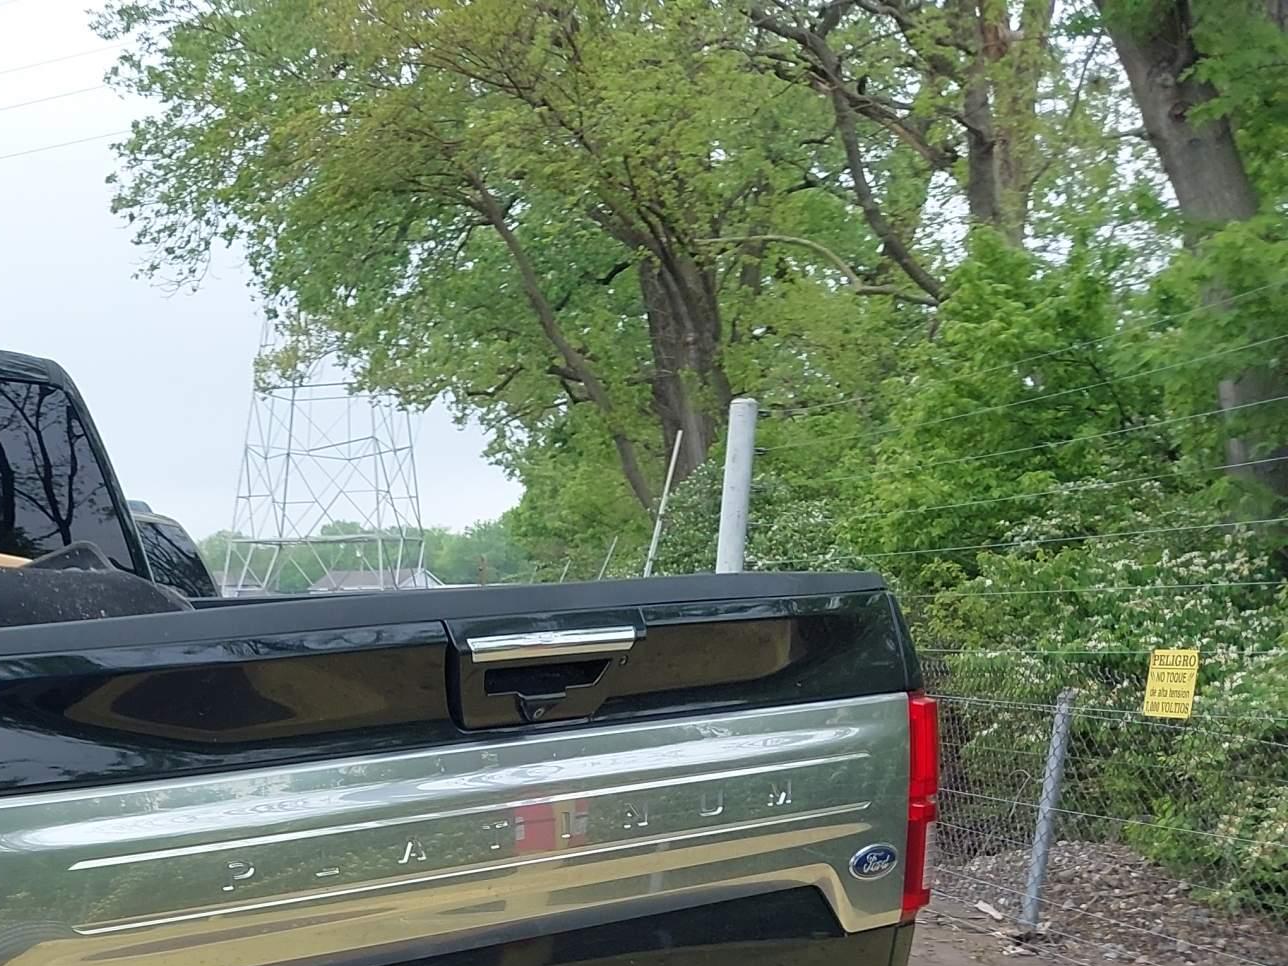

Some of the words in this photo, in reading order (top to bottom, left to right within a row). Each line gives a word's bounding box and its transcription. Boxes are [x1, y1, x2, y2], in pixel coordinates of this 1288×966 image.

[1152, 654, 1197, 667] PELIGRO
[1156, 671, 1166, 683] NO
[1167, 672, 1187, 684] TOQUE
[1149, 686, 1157, 697] de
[1157, 687, 1168, 698] alta
[1161, 702, 1190, 714] VOLTIOS
